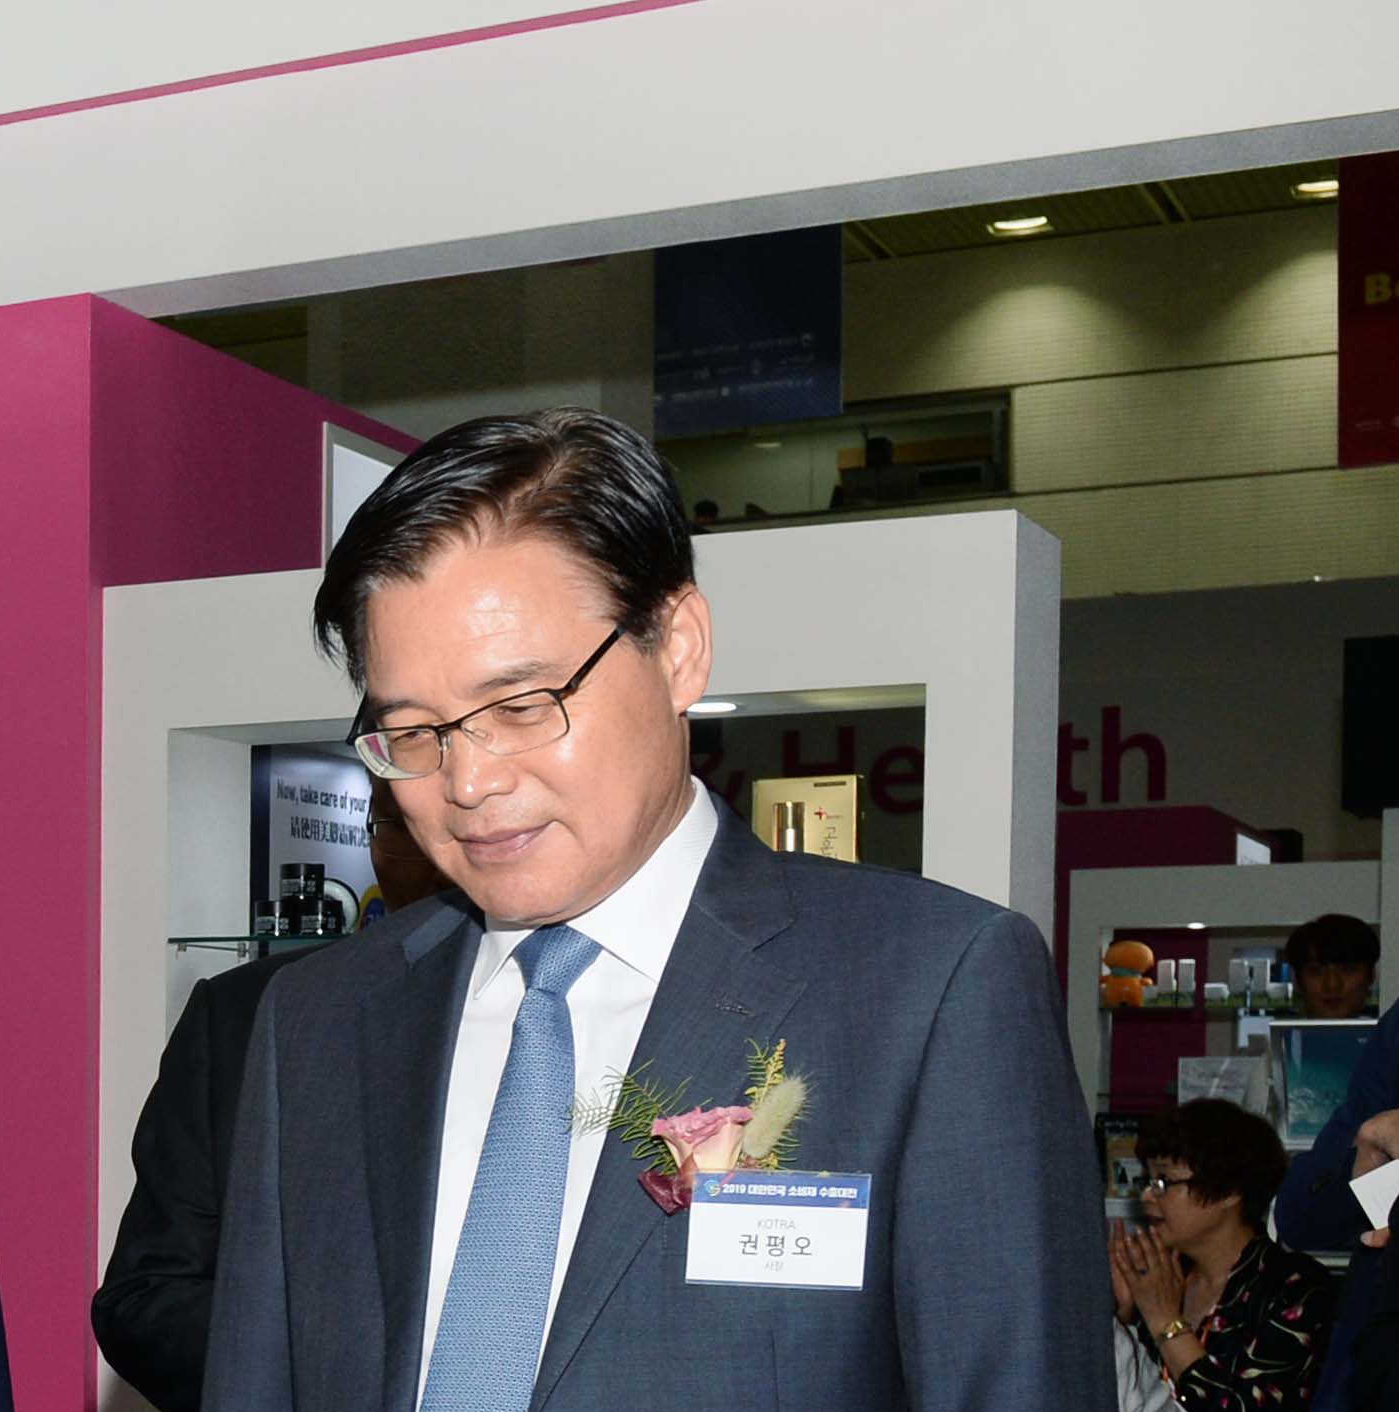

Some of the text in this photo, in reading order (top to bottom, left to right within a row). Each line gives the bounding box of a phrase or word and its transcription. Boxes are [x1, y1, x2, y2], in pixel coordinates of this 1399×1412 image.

[300, 784, 318, 805] take
[319, 791, 338, 809] care
[722, 1183, 747, 1195] 2019
[757, 1218, 796, 1230] KOTRA
